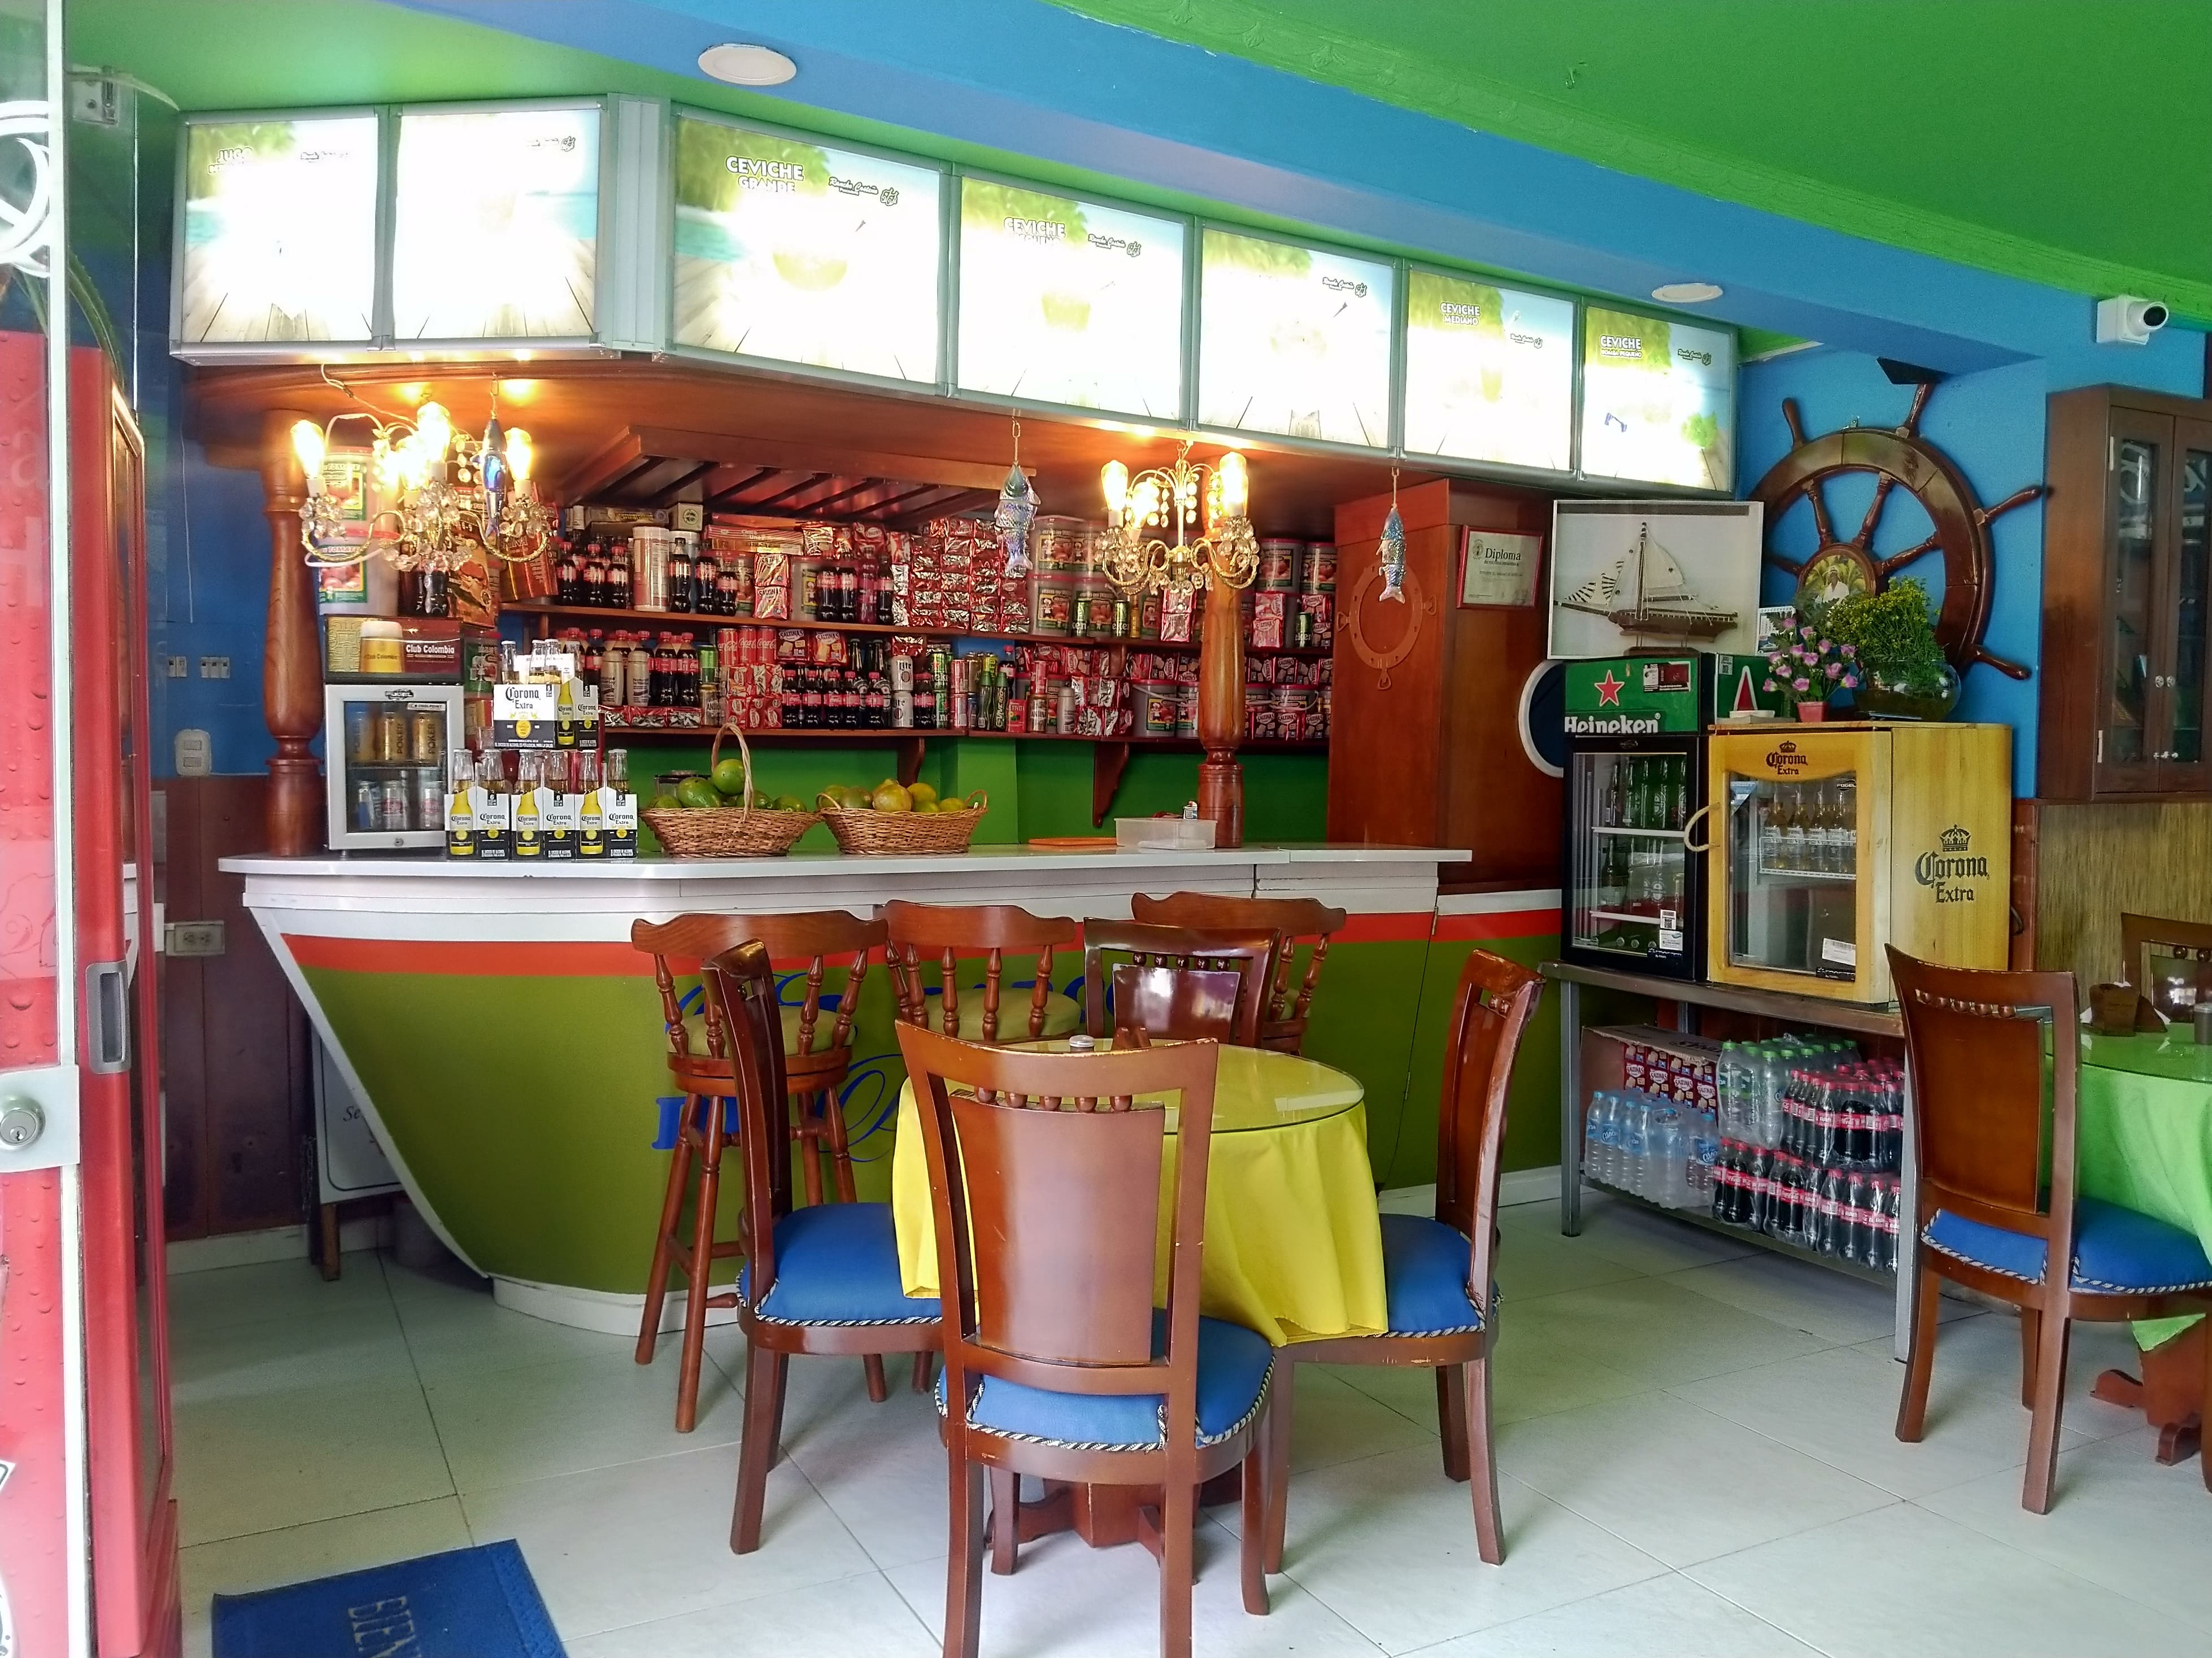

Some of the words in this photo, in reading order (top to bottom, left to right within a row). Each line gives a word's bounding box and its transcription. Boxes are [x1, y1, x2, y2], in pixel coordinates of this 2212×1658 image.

[726, 155, 804, 181] CEVICHE
[1003, 217, 1066, 237] CEVICHE
[1440, 302, 1481, 317] CEVICHE
[1444, 315, 1479, 326] MEDIANO
[1600, 335, 1641, 350] CEVICHE
[1485, 548, 1521, 561] Diploma
[778, 630, 804, 639] SALTINAS
[816, 632, 841, 641] SALTINAS
[406, 645, 422, 653] Club
[423, 645, 454, 654] Colombia
[899, 660, 912, 670] Lite
[506, 686, 541, 704] Corona
[515, 700, 533, 709] Extra
[1564, 715, 1658, 734] Heineken
[1766, 752, 1808, 768] Corona
[1777, 765, 1799, 775] Extra
[1915, 850, 1990, 889] Corona
[1936, 881, 1975, 903] Extra
